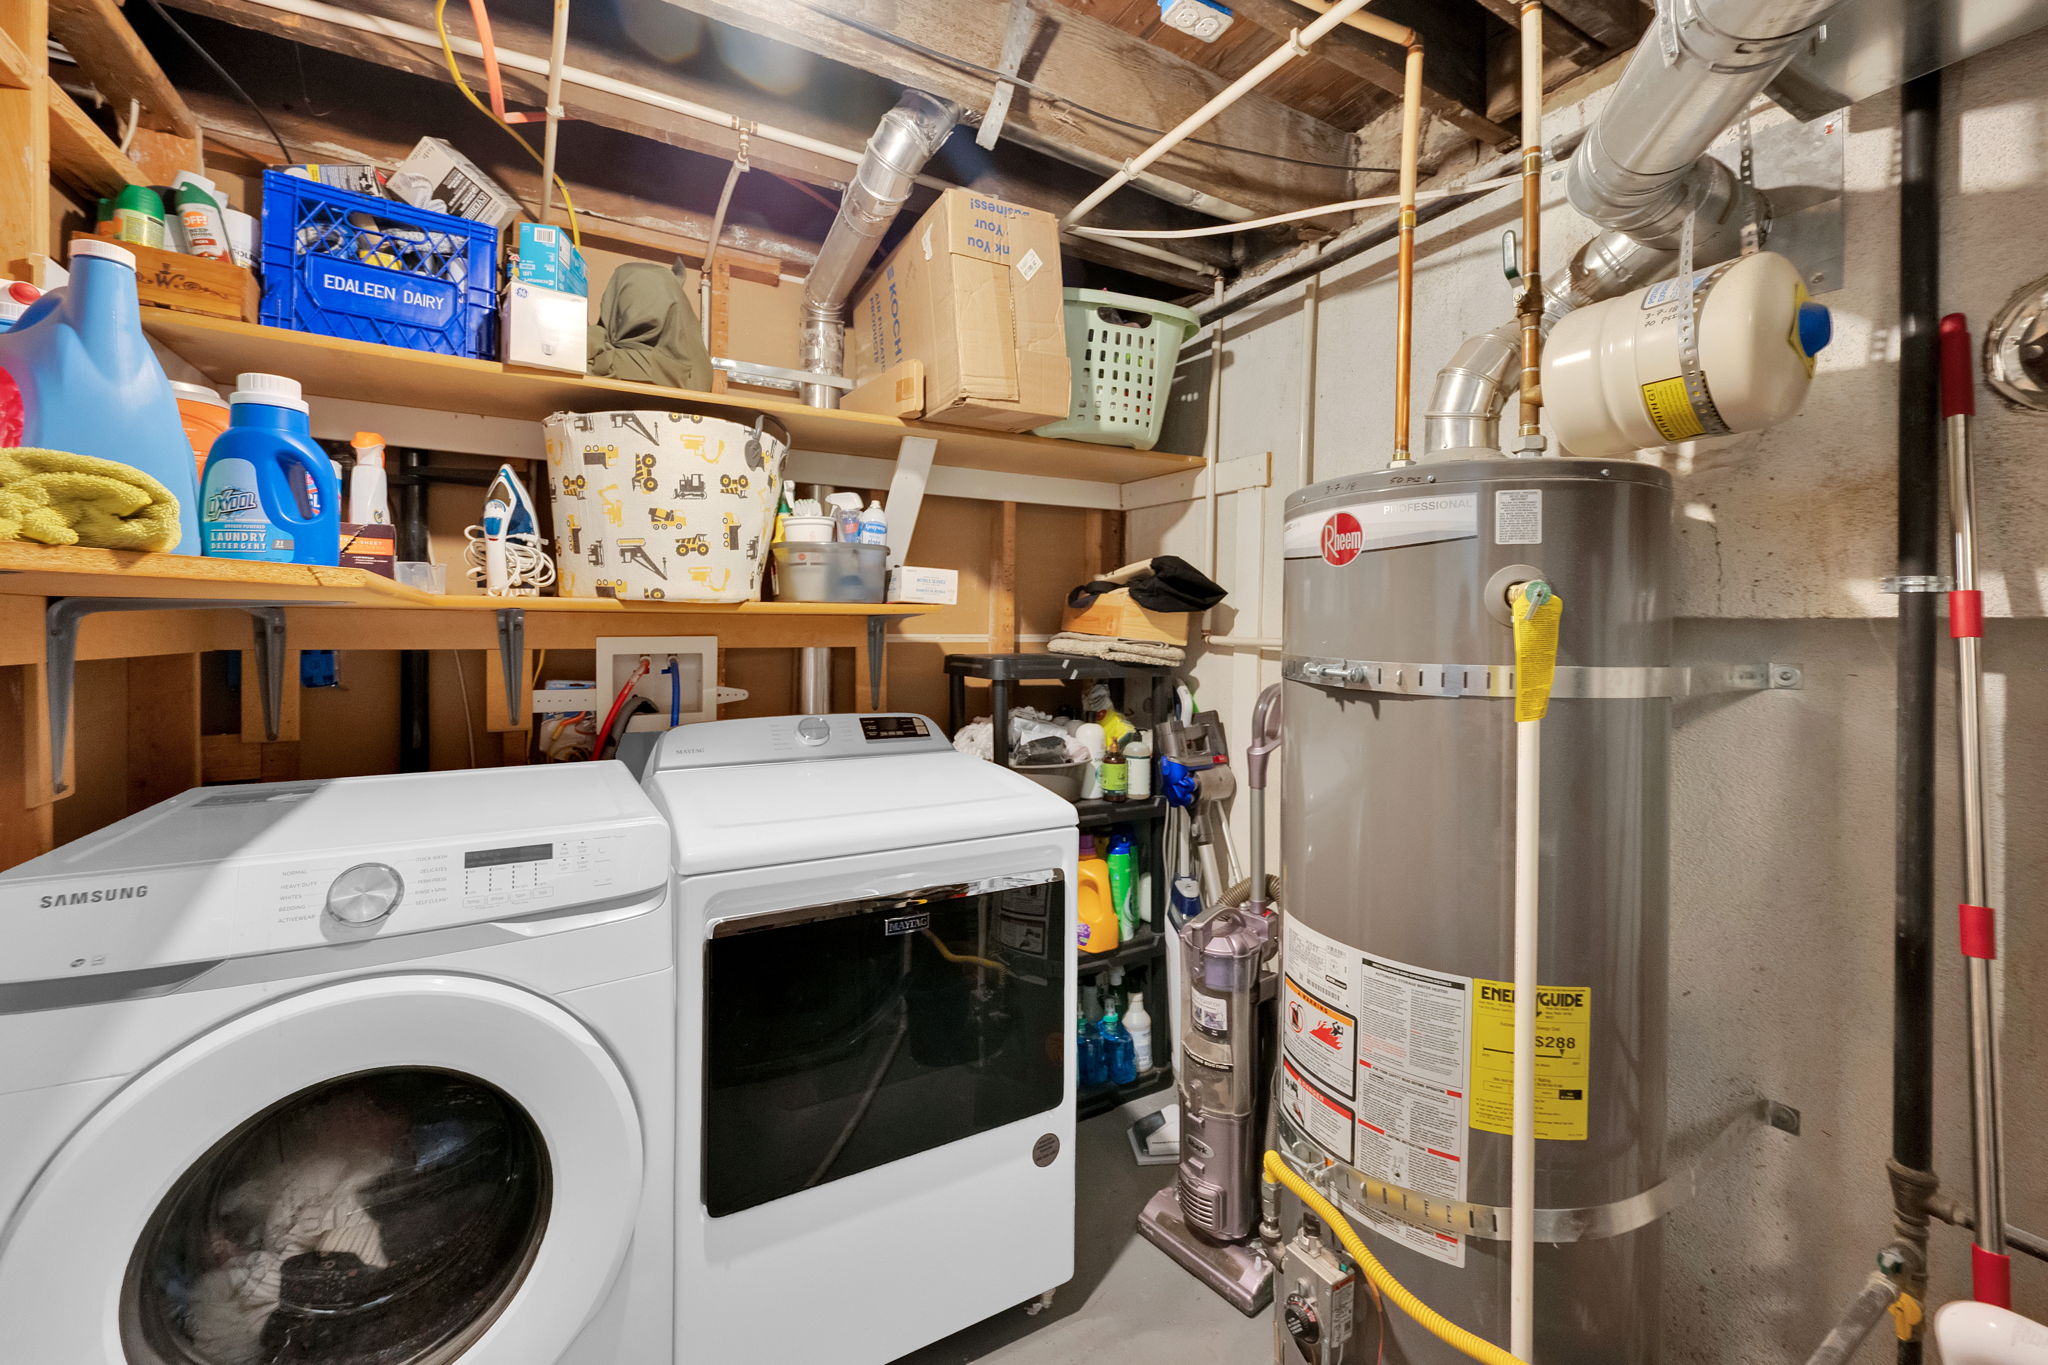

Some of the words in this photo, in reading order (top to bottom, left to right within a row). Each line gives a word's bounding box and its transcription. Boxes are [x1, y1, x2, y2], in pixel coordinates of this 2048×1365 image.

[324, 273, 396, 301] EDALEEN
[403, 289, 445, 311] DAIRY
[886, 283, 903, 358] KOCH
[210, 533, 267, 542] LAUNDRY
[1325, 513, 1362, 559] Rheem
[39, 885, 148, 909] SAMSUNG
[888, 917, 929, 932] MAYTAG
